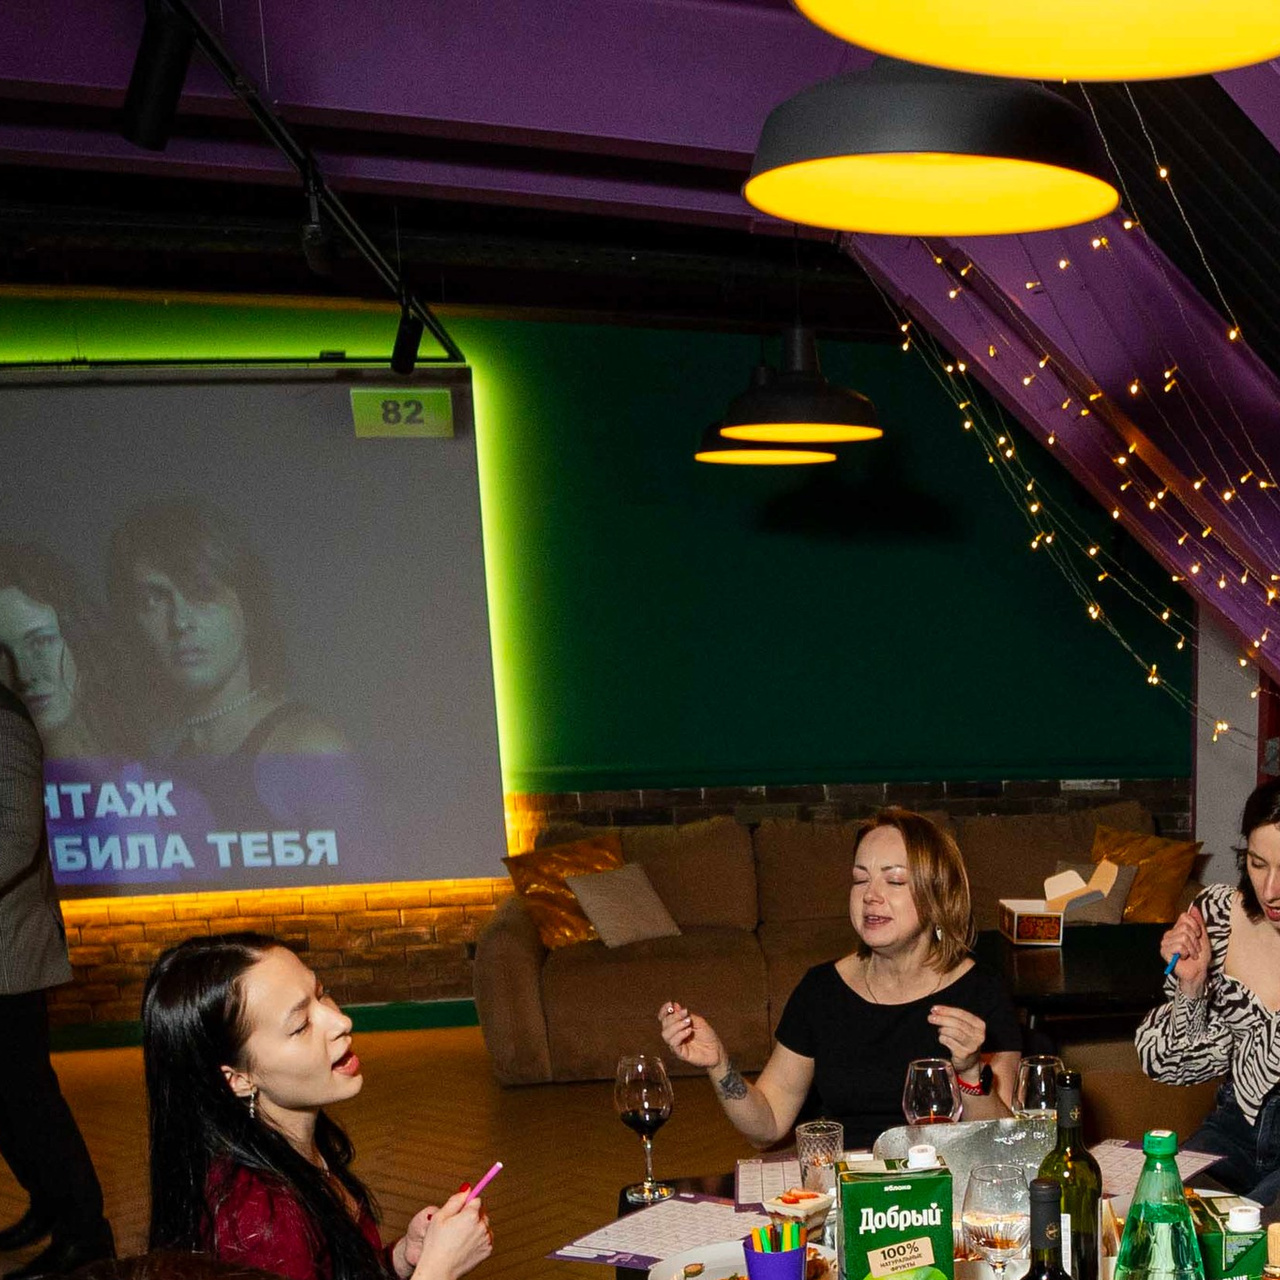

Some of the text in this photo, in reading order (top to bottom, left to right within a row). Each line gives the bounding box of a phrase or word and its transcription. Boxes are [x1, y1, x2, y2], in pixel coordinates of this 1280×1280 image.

[382, 400, 424, 424] 82
[53, 830, 338, 871] БИЛА ТЕБЯ
[859, 1203, 941, 1234] Добрый
[881, 1242, 919, 1260] 100%
[890, 1262, 916, 1272] ФРУКТЫ
